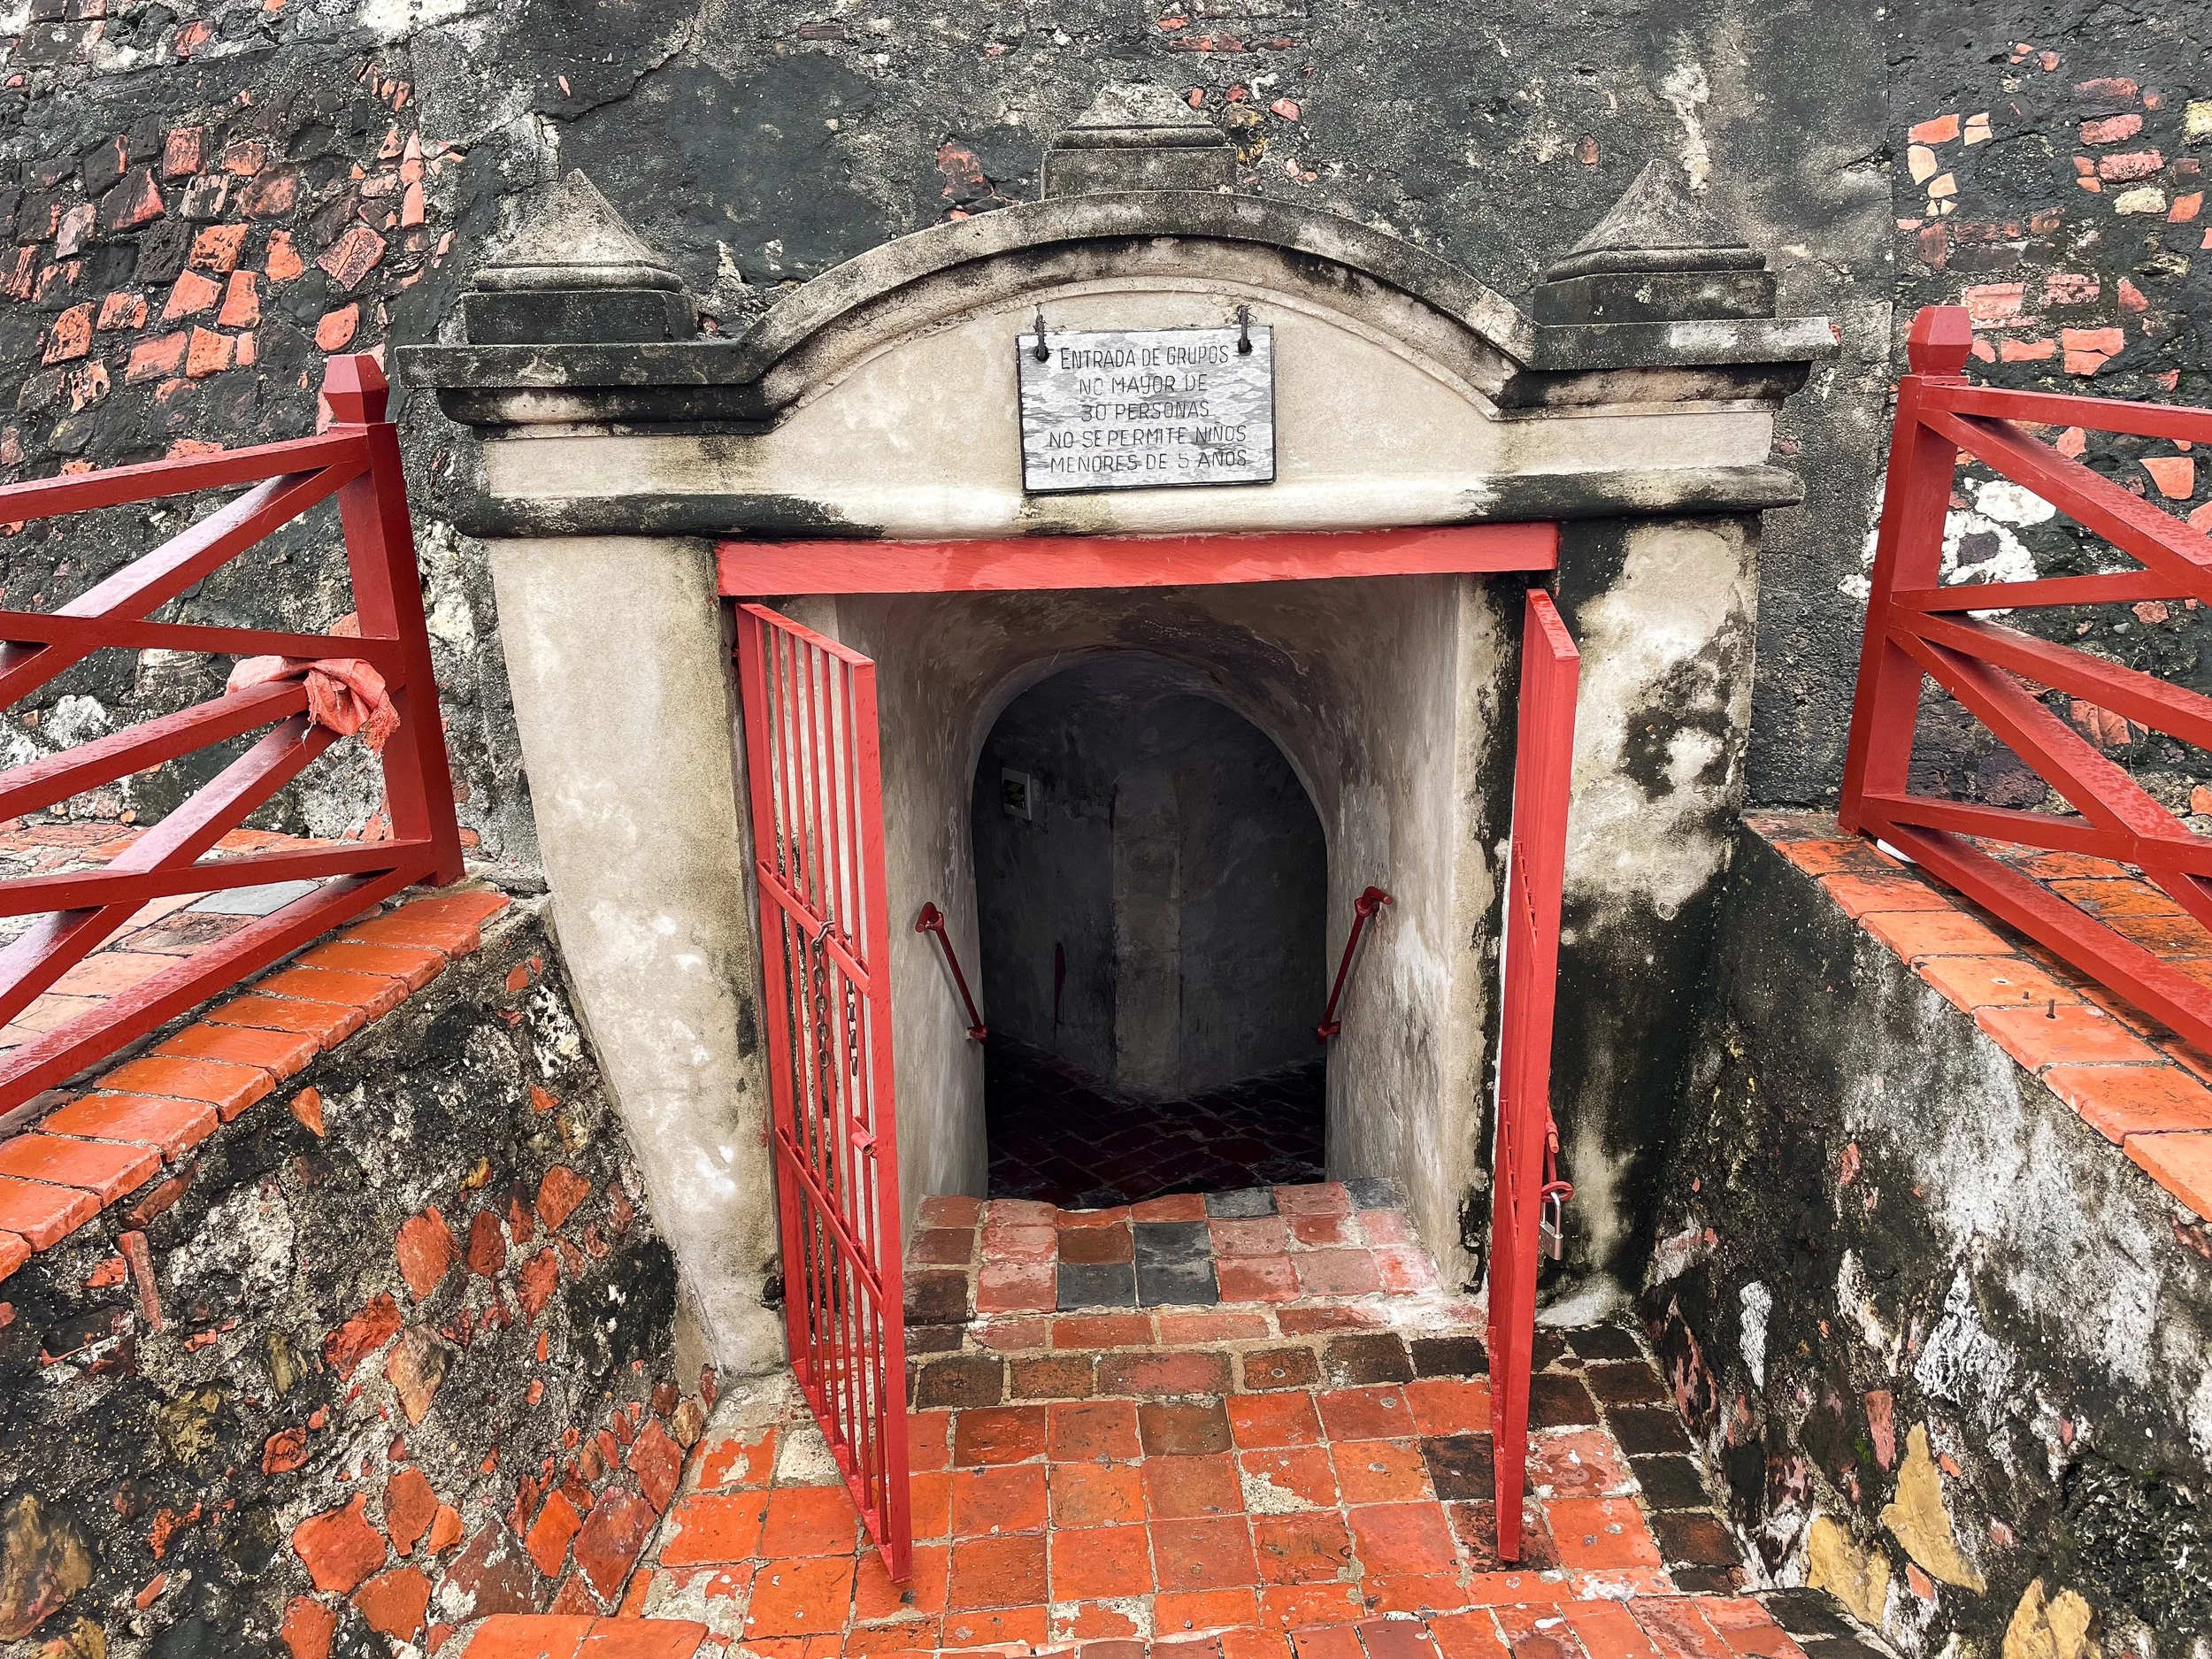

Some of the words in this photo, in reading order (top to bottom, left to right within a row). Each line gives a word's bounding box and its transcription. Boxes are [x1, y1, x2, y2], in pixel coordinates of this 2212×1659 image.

[1061, 347, 1135, 369] ENTRADA
[1142, 348, 1161, 366] DE
[1166, 345, 1229, 365] GRUPOS
[1079, 378, 1103, 395] NO
[1111, 375, 1175, 394] MAYOR
[1185, 373, 1209, 391] DE
[1081, 404, 1107, 422] 30
[1115, 401, 1210, 420] PERSONAS
[1049, 431, 1074, 449] NO
[1082, 430, 1102, 447] SE
[1108, 426, 1187, 446] PERMITE
[1195, 421, 1247, 442] NIÑOS
[1050, 454, 1138, 472] MENORES
[1146, 453, 1167, 470] DE
[1179, 453, 1189, 469] 5
